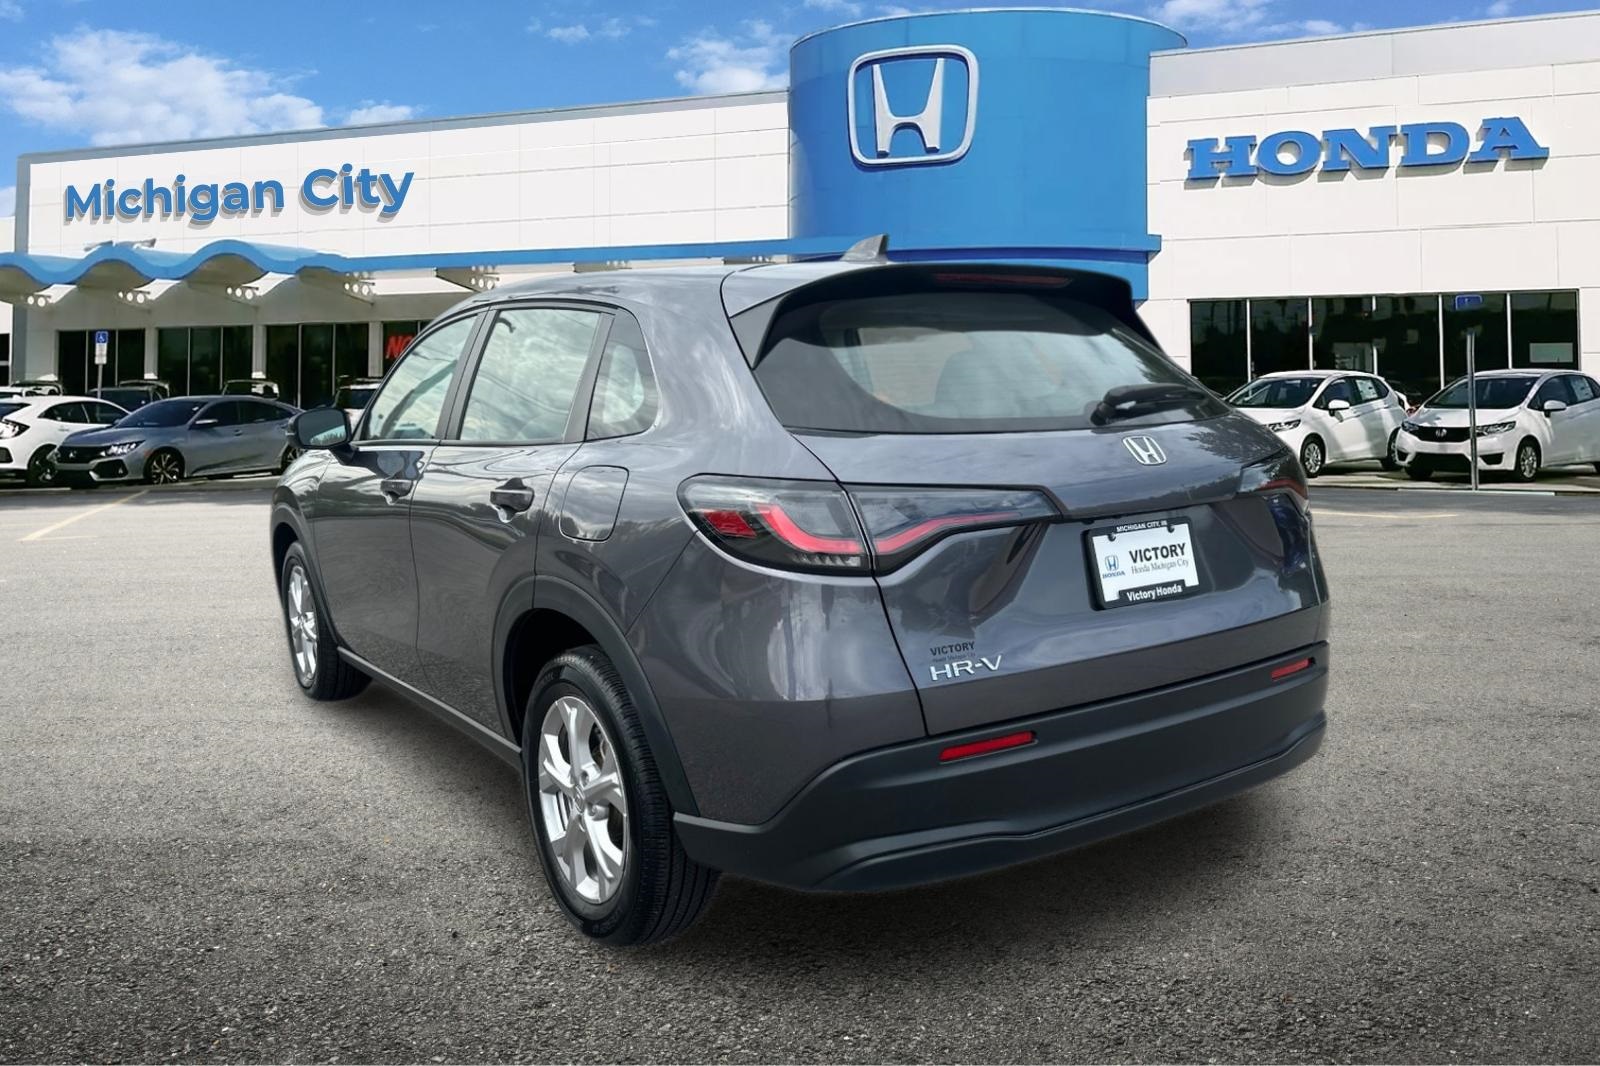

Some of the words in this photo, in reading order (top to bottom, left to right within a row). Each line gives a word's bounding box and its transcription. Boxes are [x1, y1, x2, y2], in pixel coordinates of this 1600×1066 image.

[1186, 116, 1550, 181] HONDA
[65, 173, 285, 223] Michigan
[302, 163, 415, 215] City
[1116, 523, 1146, 532] MICHIGAN
[1129, 543, 1186, 563] VICTORY
[1131, 565, 1150, 575] Honda
[1150, 560, 1177, 572] Michigan
[1126, 588, 1156, 601] Victory
[1156, 584, 1182, 596] Honda
[930, 641, 975, 656] VICTORY
[929, 655, 1002, 681] HR-V
